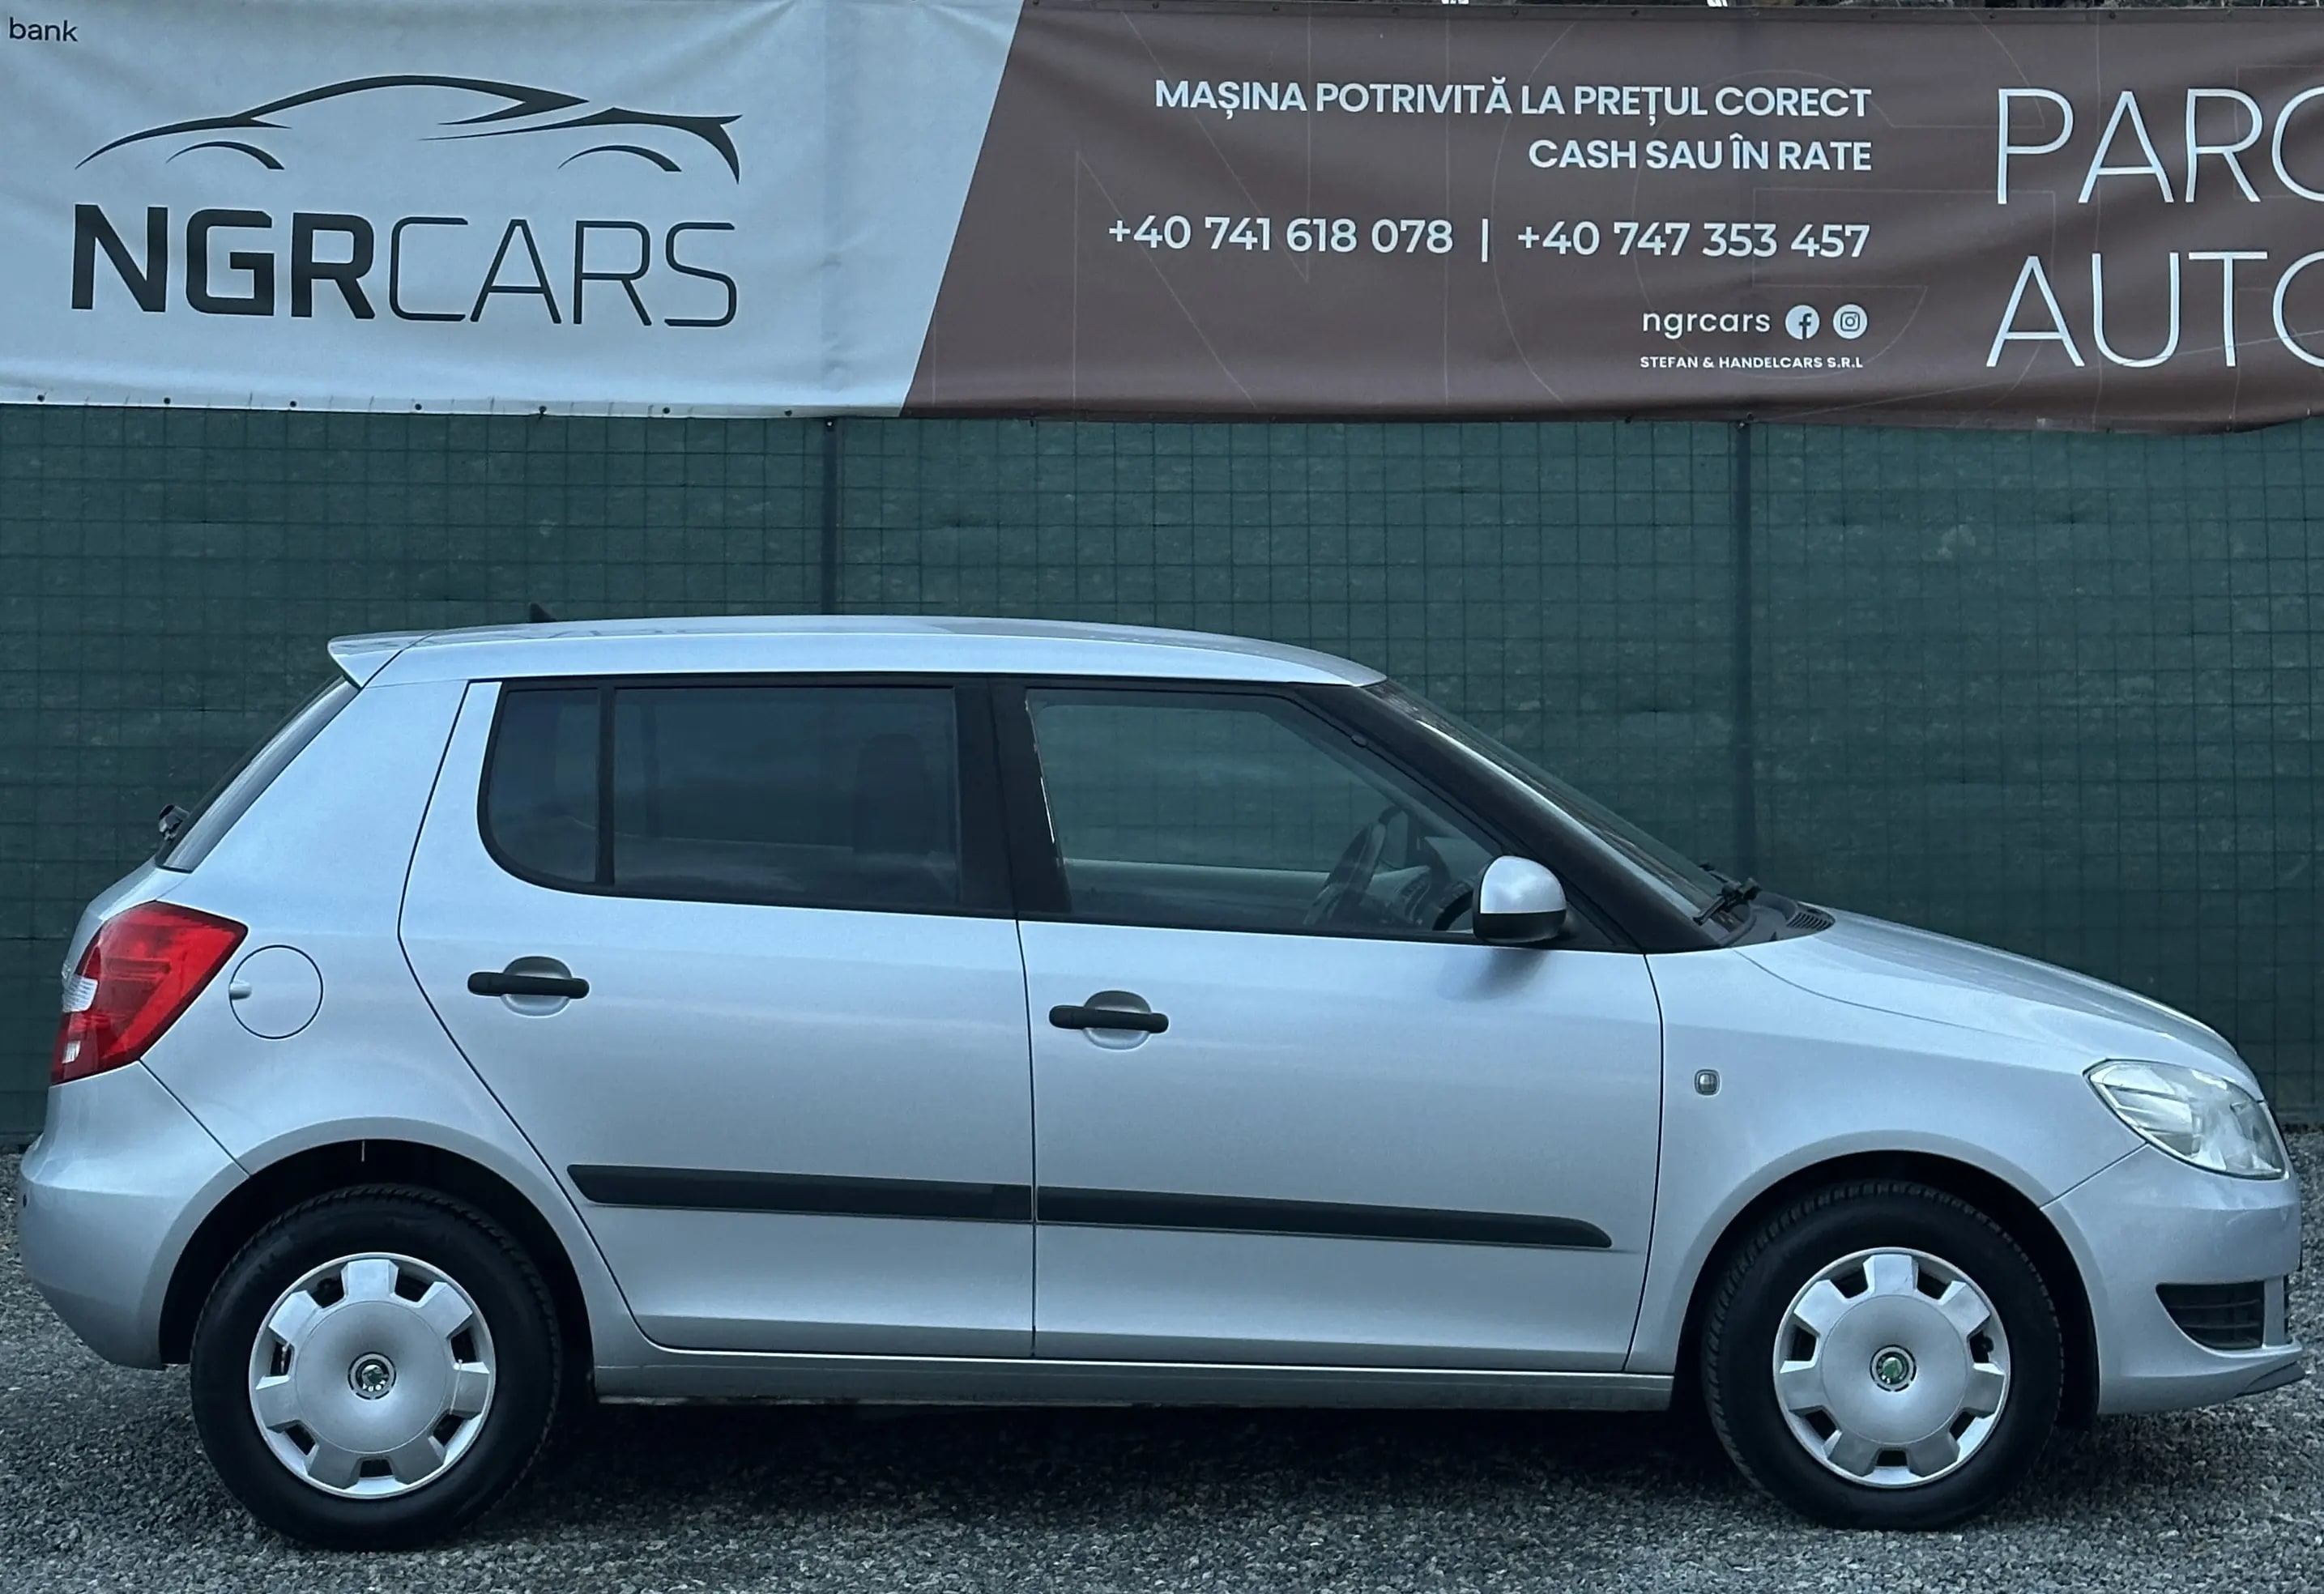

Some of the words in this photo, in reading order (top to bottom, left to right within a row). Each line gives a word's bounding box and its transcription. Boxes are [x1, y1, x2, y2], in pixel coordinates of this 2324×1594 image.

[9, 16, 78, 42] bank
[1155, 79, 1307, 120] MAȘINA
[1316, 76, 1513, 115] POTRIVITĂ
[1521, 85, 1566, 115] LA
[1574, 86, 1708, 127] PREȚUL
[1715, 87, 1872, 117] CORECT
[1529, 139, 1636, 169] CASH
[1645, 140, 1722, 169] SAU
[1729, 132, 1769, 170] ÎN
[1779, 141, 1872, 171] RATE
[1108, 215, 1192, 249] +40
[1205, 216, 1271, 251] 741
[1286, 218, 1357, 253] 618
[1371, 219, 1453, 254] 078
[1517, 220, 1600, 255] +40
[1614, 221, 1691, 256] 747
[1702, 223, 1777, 258] 353
[1790, 224, 1870, 258] 457
[71, 203, 737, 328] NGRCARS
[1643, 312, 1771, 340] ngrcars
[1640, 356, 1699, 369] STEFAN
[1702, 356, 1715, 369] &
[1719, 356, 1823, 369] HANDELCARS
[1827, 356, 1864, 369] S.R.L
